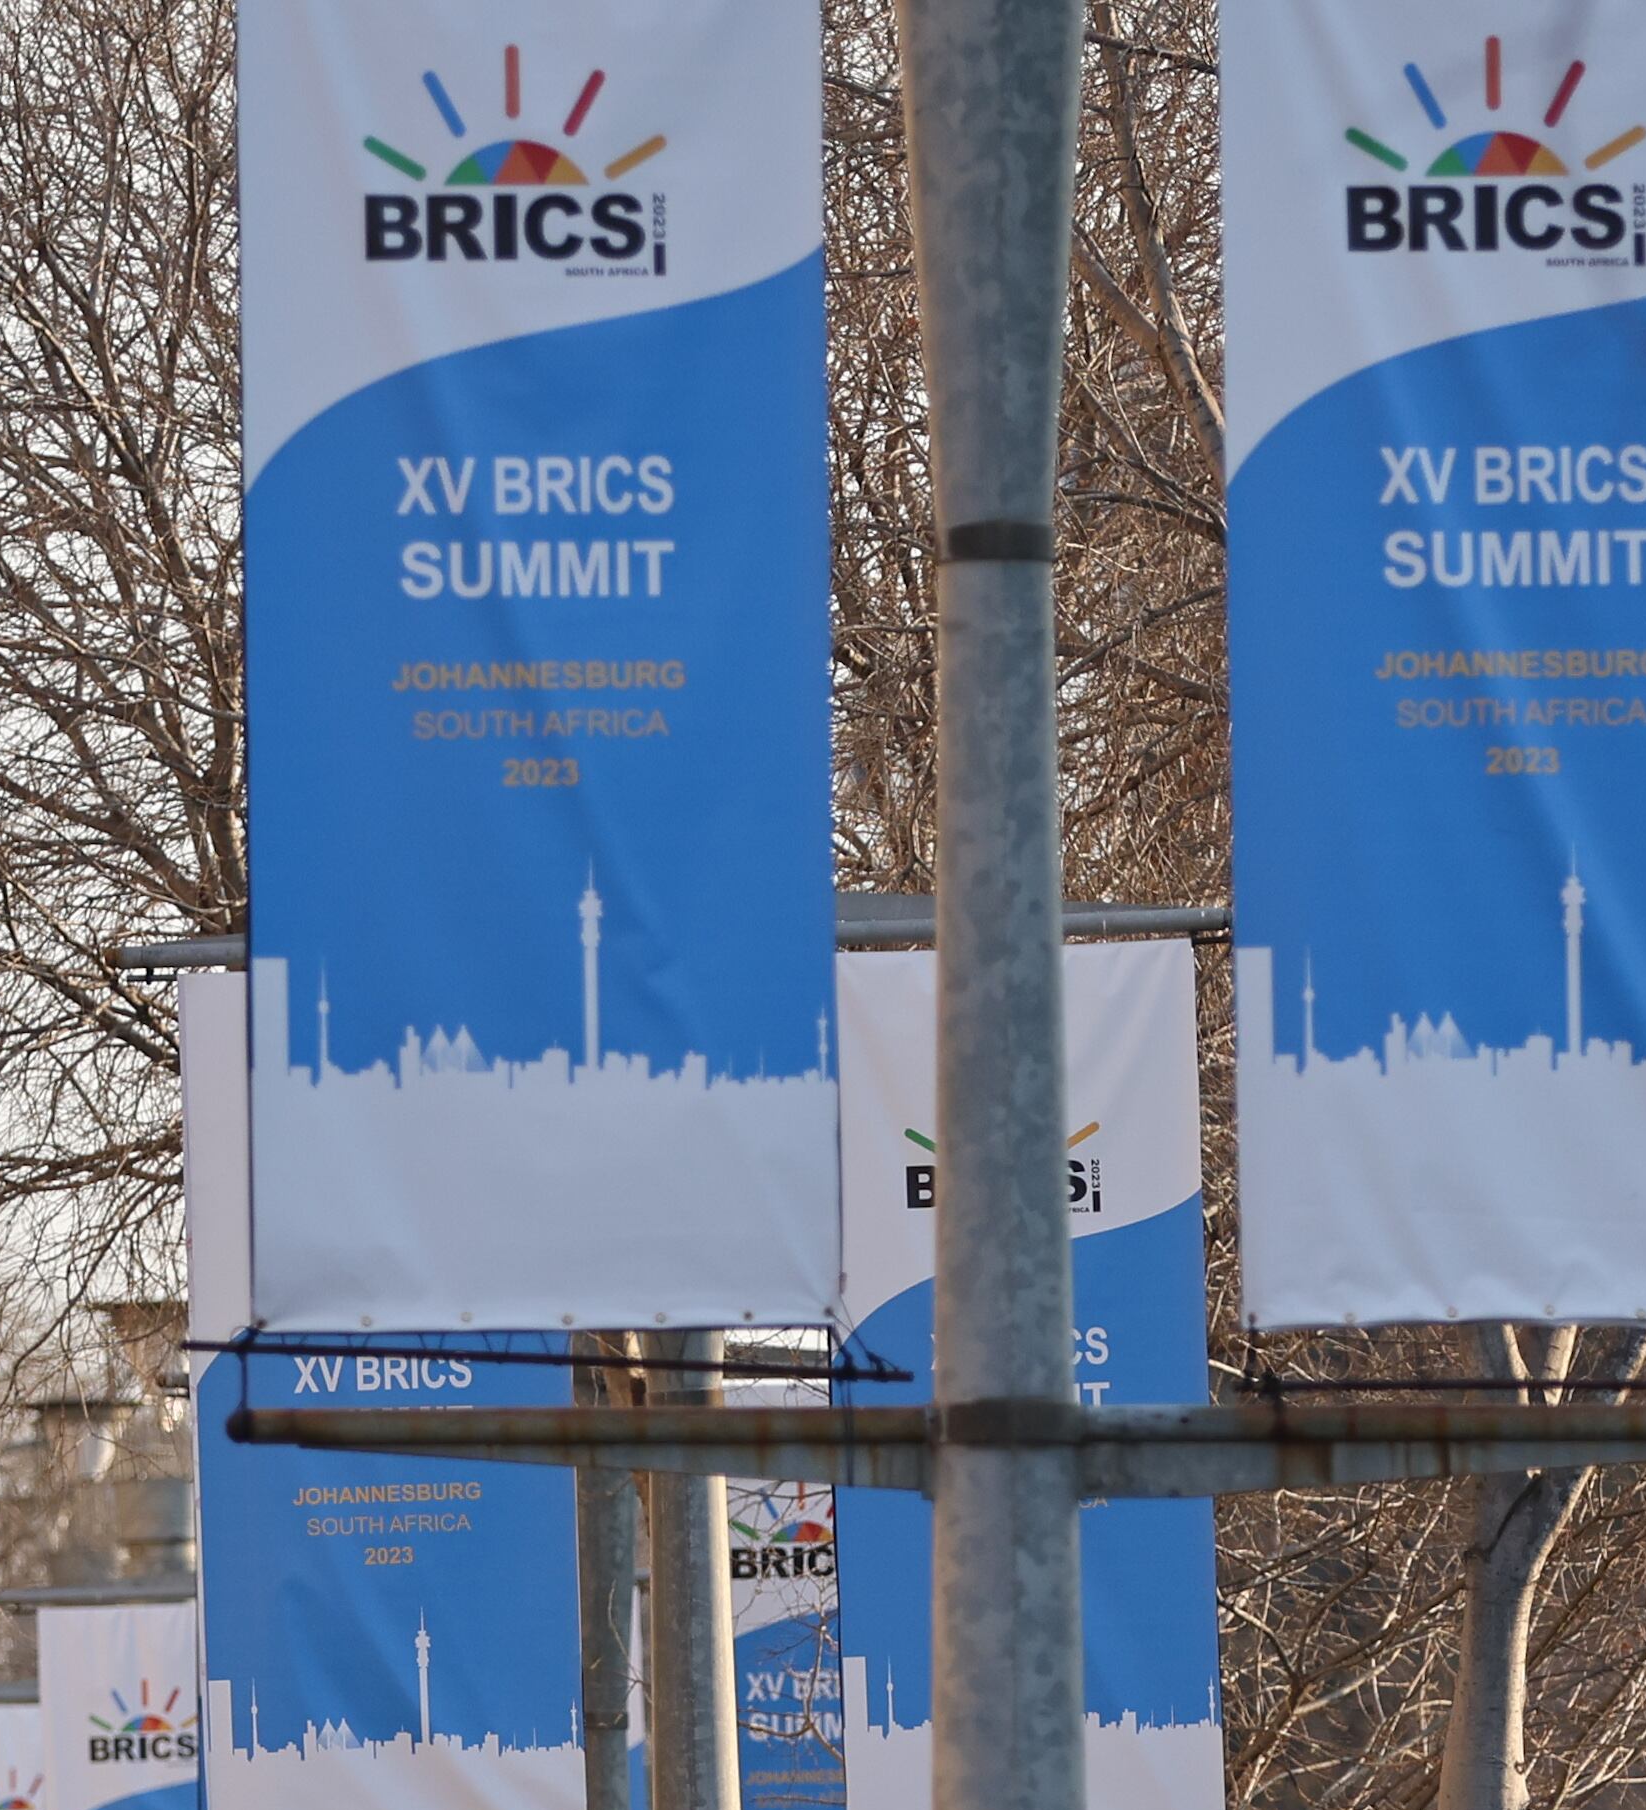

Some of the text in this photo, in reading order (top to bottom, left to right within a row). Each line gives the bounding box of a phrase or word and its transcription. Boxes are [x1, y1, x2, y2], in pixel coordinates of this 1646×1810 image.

[652, 193, 667, 240] 2023
[1346, 184, 1627, 252] BRICS
[1633, 183, 1646, 230] 2023
[364, 193, 646, 263] BRICS
[565, 266, 649, 277] SOUTH AFRICA
[396, 454, 674, 514] XV BRICS
[1380, 446, 1457, 505] XV
[400, 540, 675, 599] SUMMIT
[392, 659, 686, 692] JOHANNESBURG
[413, 708, 669, 740] SOUTH AFRICA
[1396, 699, 1515, 728] SOUTH
[502, 757, 579, 788] 2023
[1485, 746, 1560, 776] 2023
[1090, 1159, 1102, 1190] 2023
[293, 1355, 473, 1394] XV BRICS
[292, 1482, 482, 1507] JOHANNESBURG
[306, 1515, 472, 1537] SOUTH AFRICA
[364, 1547, 414, 1566] 2023
[89, 1735, 197, 1763] BRICS
